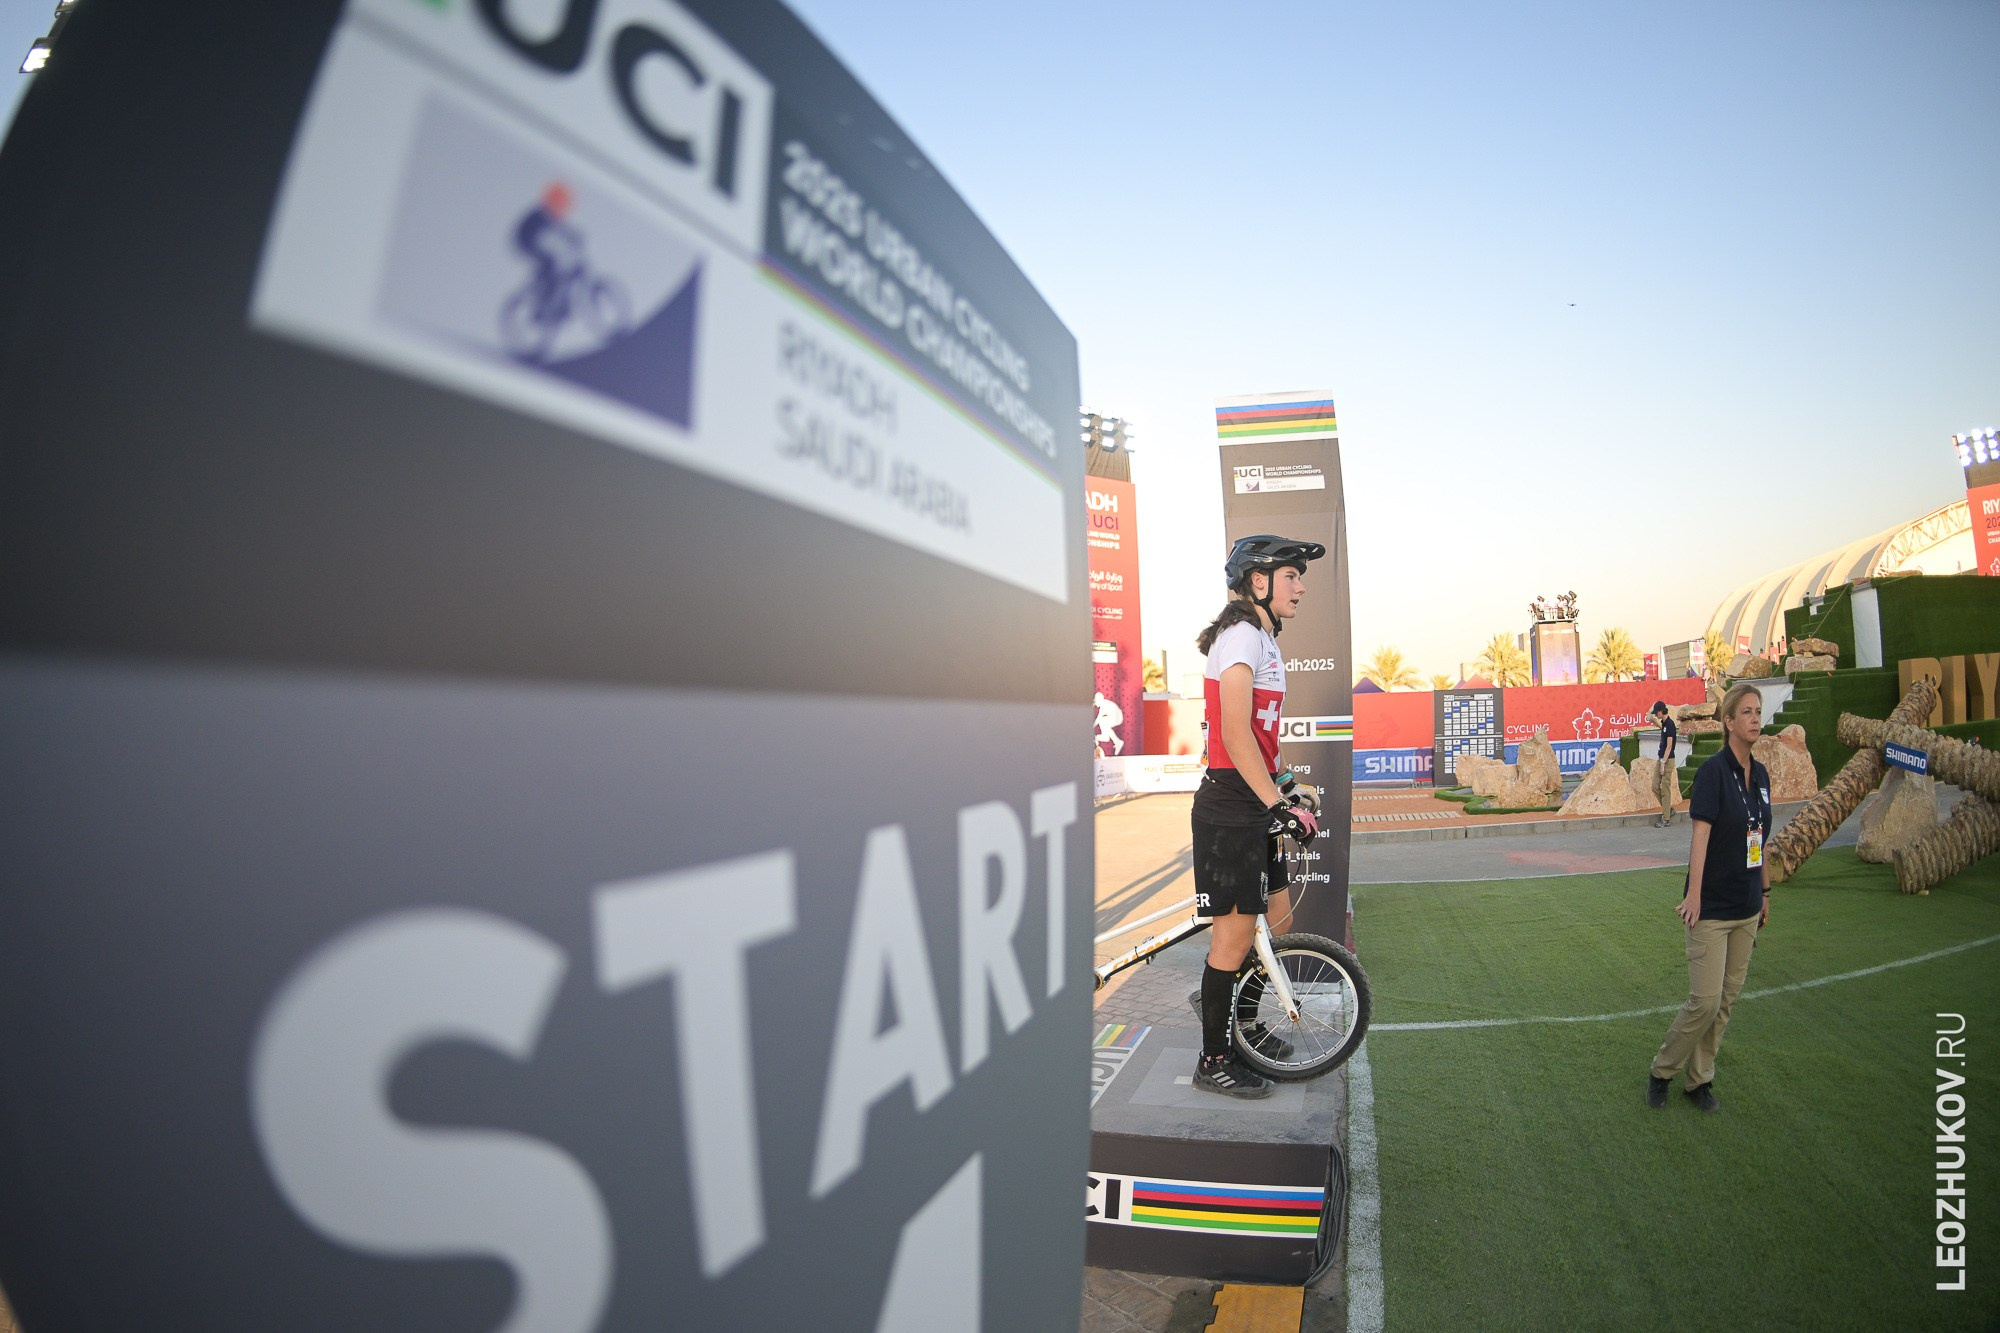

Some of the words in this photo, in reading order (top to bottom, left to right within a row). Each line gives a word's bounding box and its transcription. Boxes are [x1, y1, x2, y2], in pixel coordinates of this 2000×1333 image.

[783, 141, 862, 237] 2025
[864, 209, 953, 321] URBAN
[955, 297, 1030, 393] CYCLING
[779, 197, 902, 330] WORLD
[906, 304, 1057, 459] CHAMPIONSHIPS
[777, 319, 898, 429] RIYADH
[775, 398, 879, 490] SAUDI
[890, 459, 972, 533] ARABIA
[1239, 468, 1262, 478] UCI
[1093, 514, 1118, 530] UCI
[1506, 723, 1550, 734] CYCLING
[1610, 713, 1641, 726] الرياضة
[1886, 747, 1926, 770] SHIMANO
[250, 781, 1078, 1333] START
